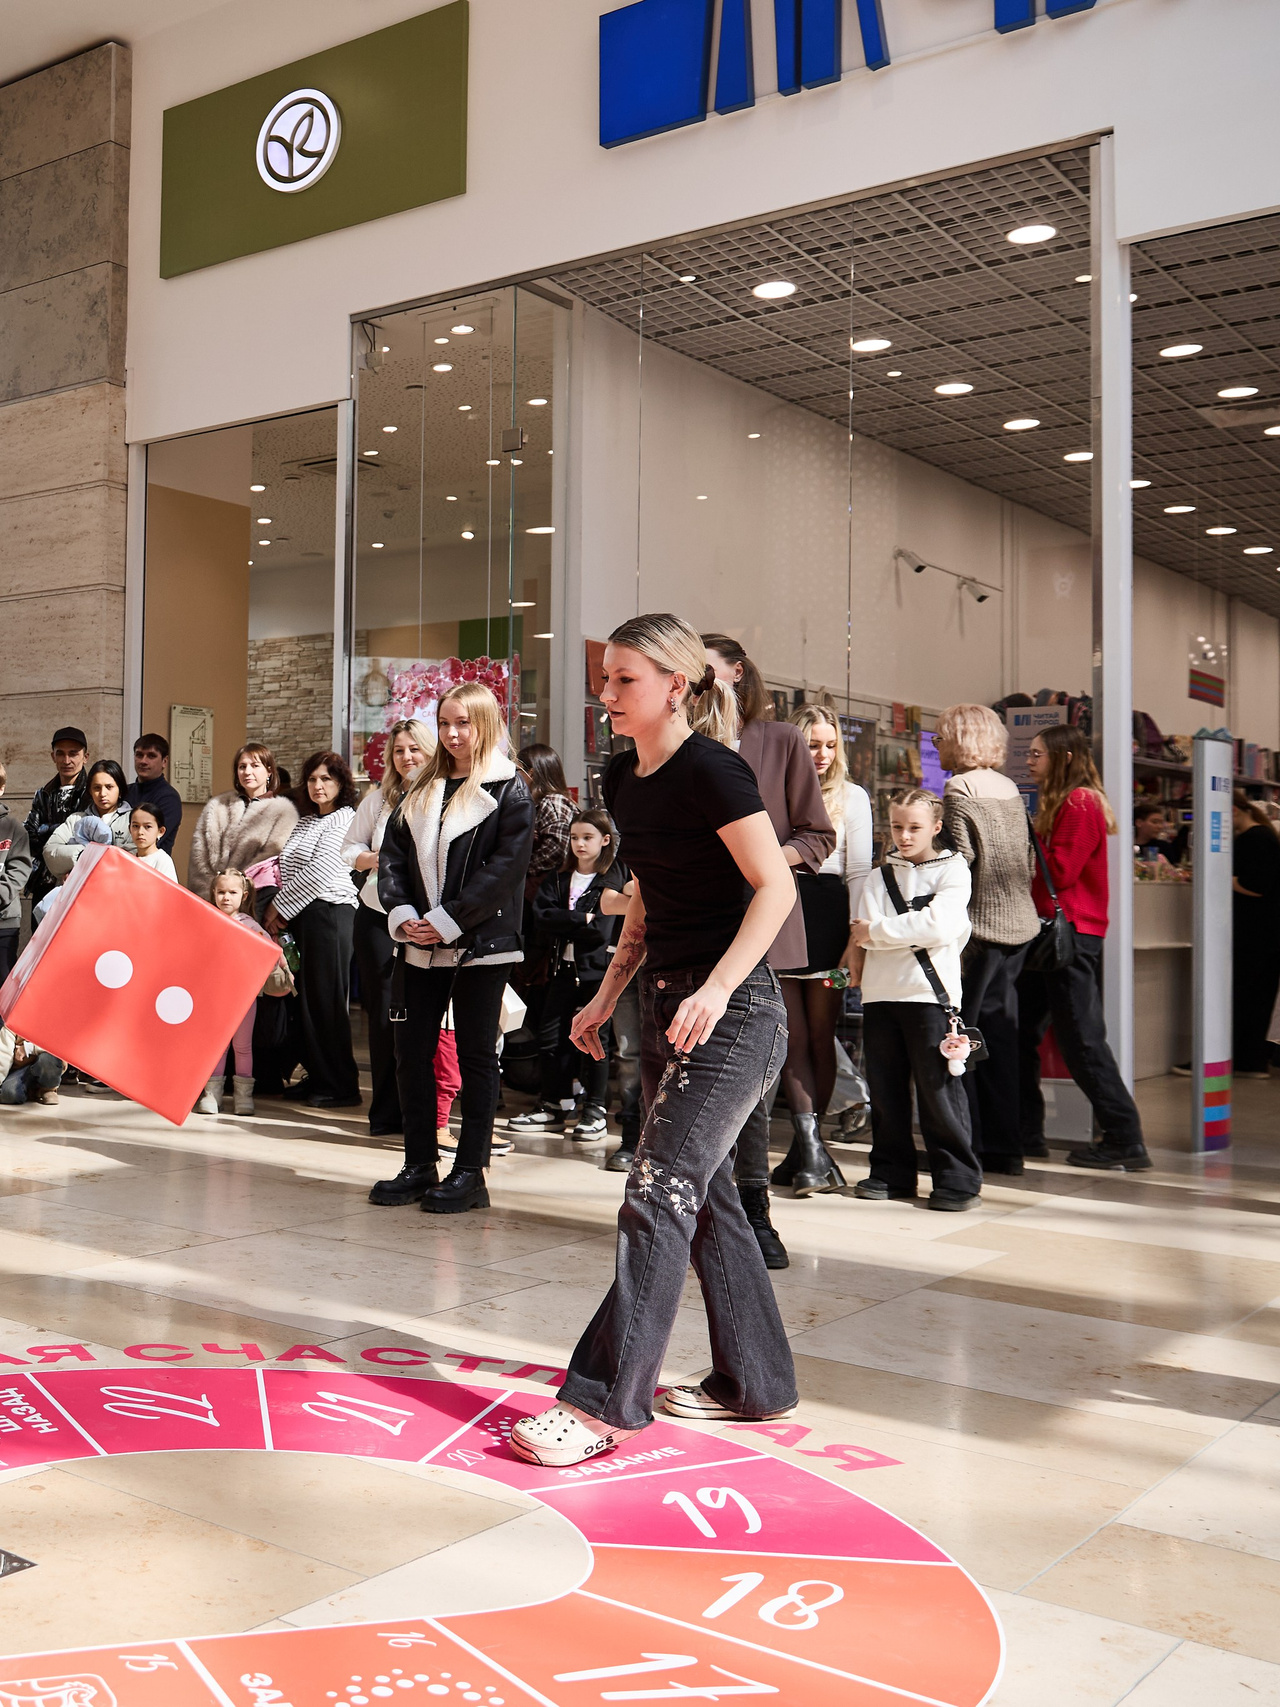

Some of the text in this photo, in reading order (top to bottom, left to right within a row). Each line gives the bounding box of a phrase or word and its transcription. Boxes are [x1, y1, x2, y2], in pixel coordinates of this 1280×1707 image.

[446, 1447, 488, 1467] 20
[557, 1445, 688, 1479] ЗАДАНИЕ
[662, 1485, 763, 1540] 19
[702, 1571, 845, 1632] 18
[376, 1631, 438, 1649] 16
[118, 1652, 179, 1672] 15
[553, 1652, 782, 1702] 17
